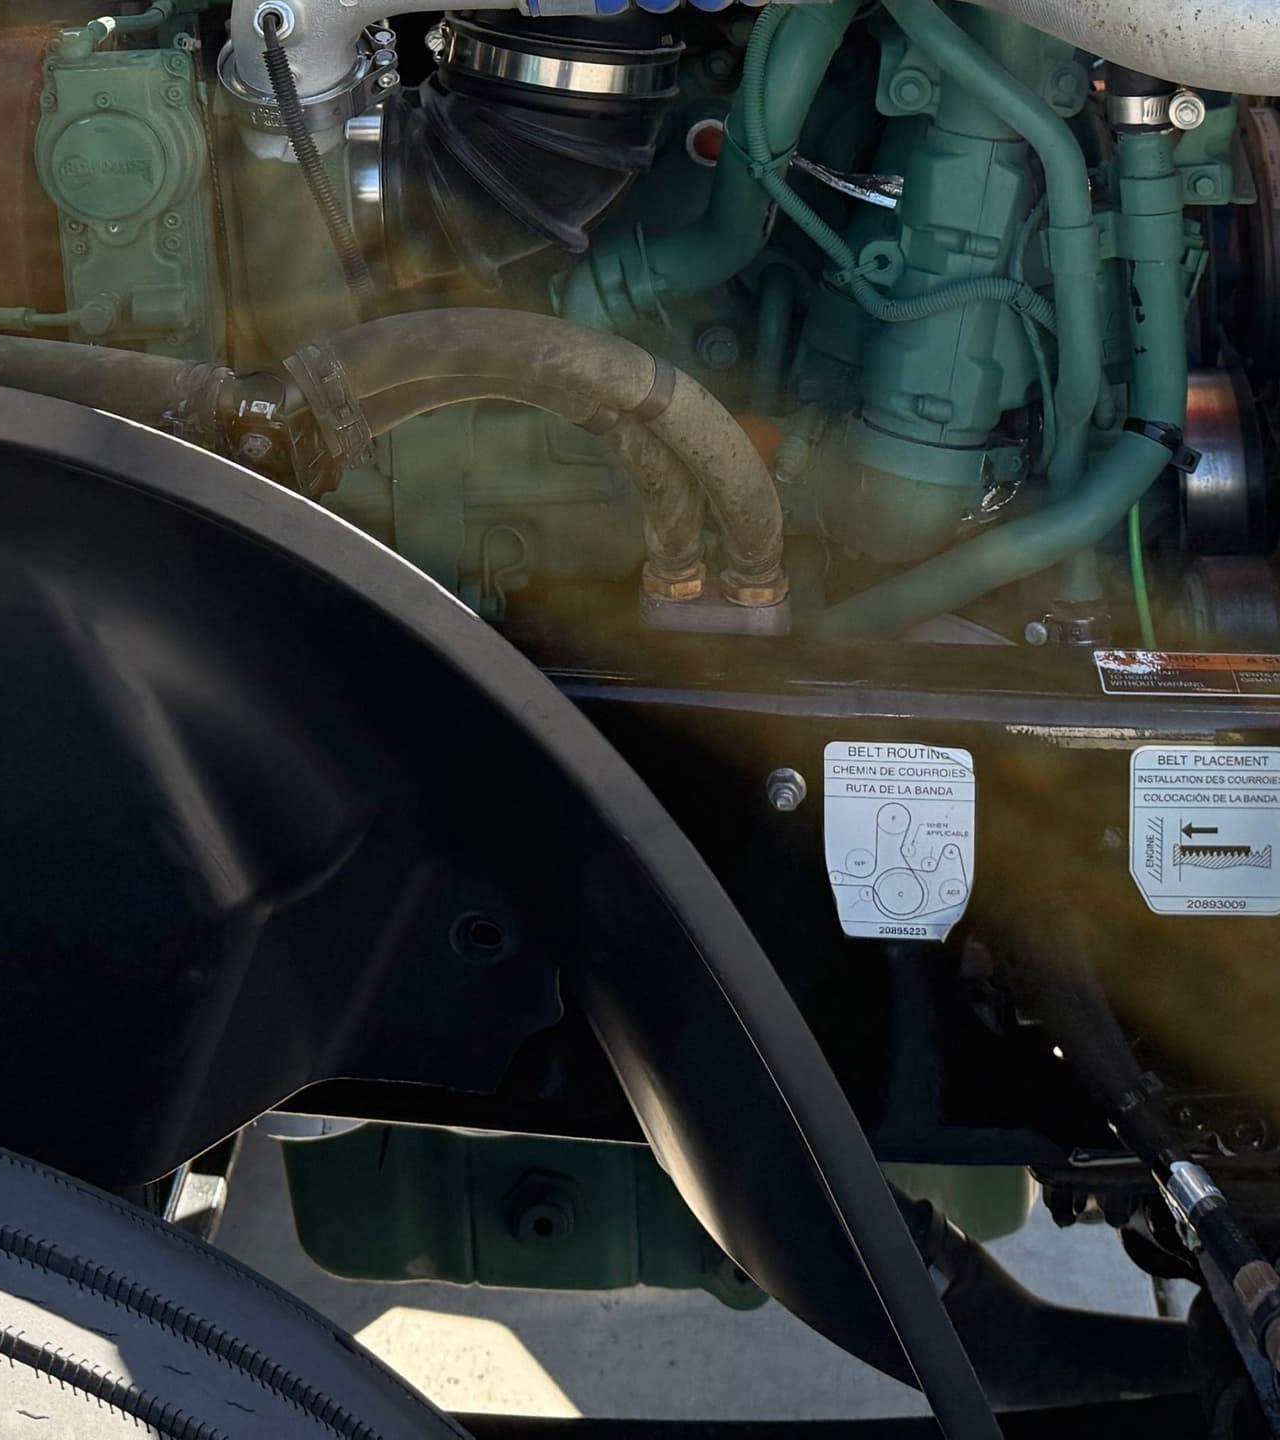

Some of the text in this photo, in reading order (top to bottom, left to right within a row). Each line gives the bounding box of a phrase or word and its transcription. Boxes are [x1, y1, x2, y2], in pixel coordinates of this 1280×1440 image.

[847, 746, 883, 758] BELT
[1158, 755, 1269, 767] BELT PLACEMENT
[833, 765, 965, 778] CHEMIN DE COURROIES
[1138, 775, 1203, 784] INSTALLATION
[1206, 776, 1225, 784] DES
[846, 783, 953, 796] RUTA DE LA BANDA
[1143, 792, 1278, 803] COLOCACIÓN DE LA BANDA
[1145, 834, 1155, 868] ENGINE
[1187, 899, 1246, 910] 20893009
[878, 926, 927, 937] 20895223
